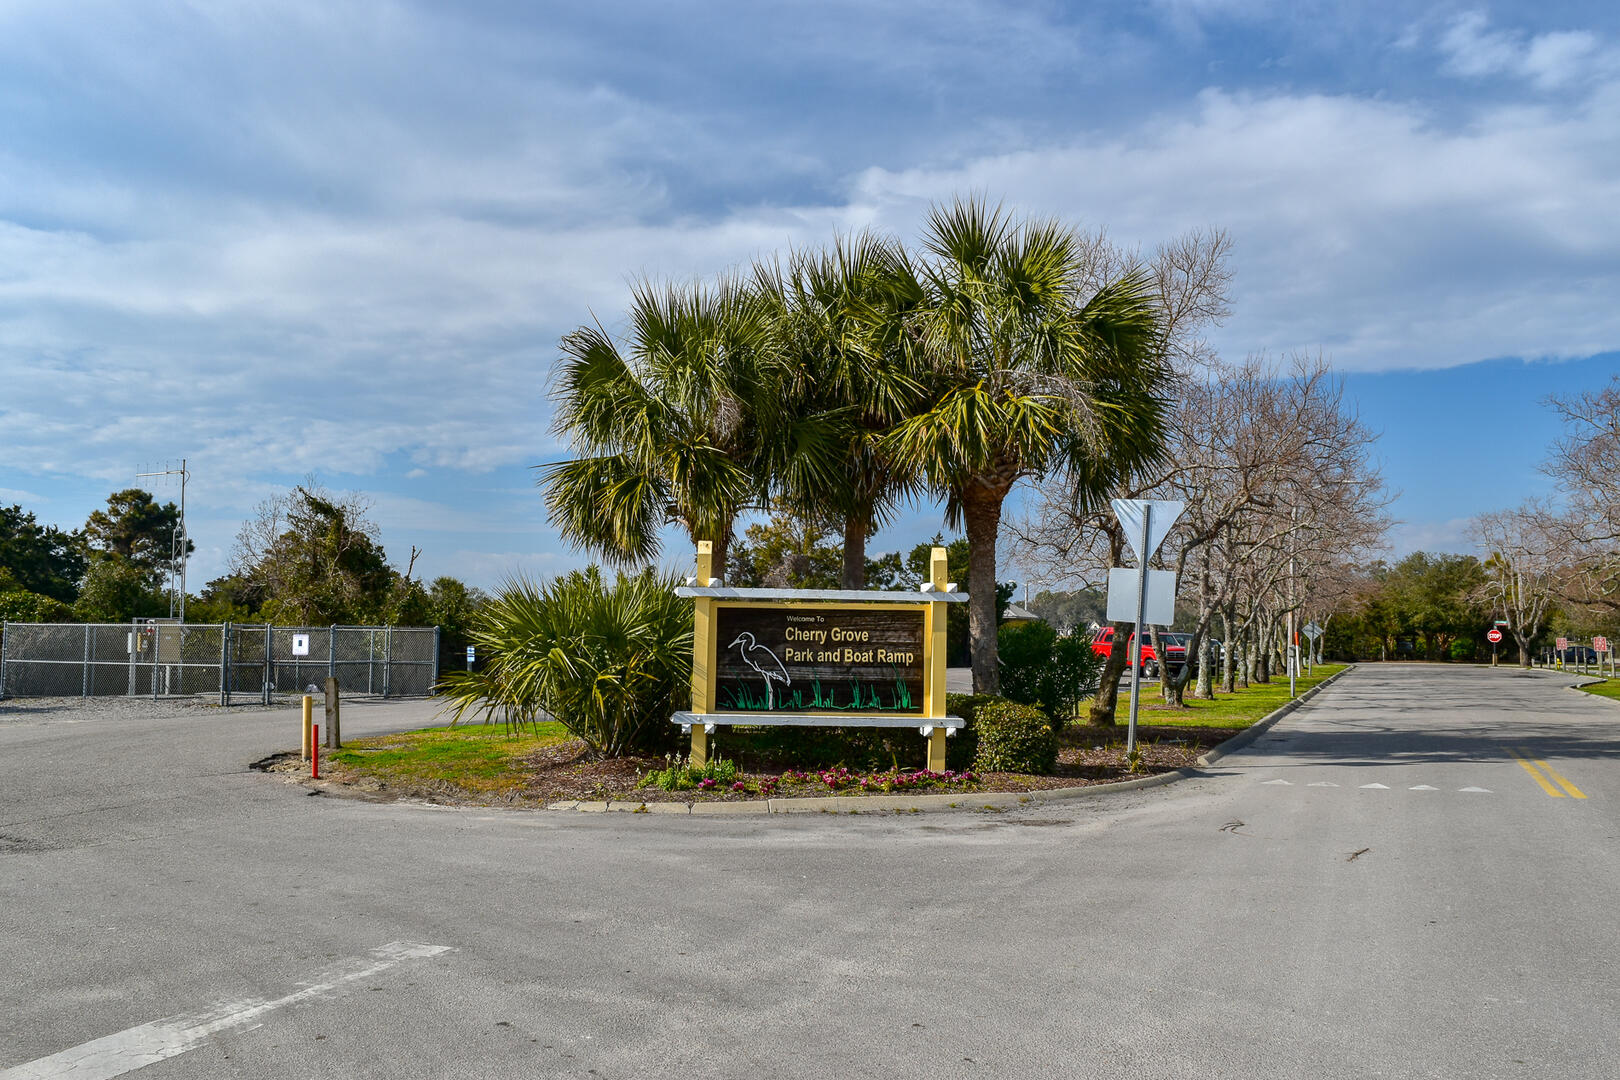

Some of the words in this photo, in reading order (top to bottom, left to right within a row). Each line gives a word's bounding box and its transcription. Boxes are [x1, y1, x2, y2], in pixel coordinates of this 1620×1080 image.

[785, 626, 827, 645] Cherry
[831, 627, 869, 642] Grove
[785, 648, 814, 662] Park
[817, 648, 840, 662] and
[844, 648, 874, 663] Boat
[877, 649, 914, 667] Ramp
